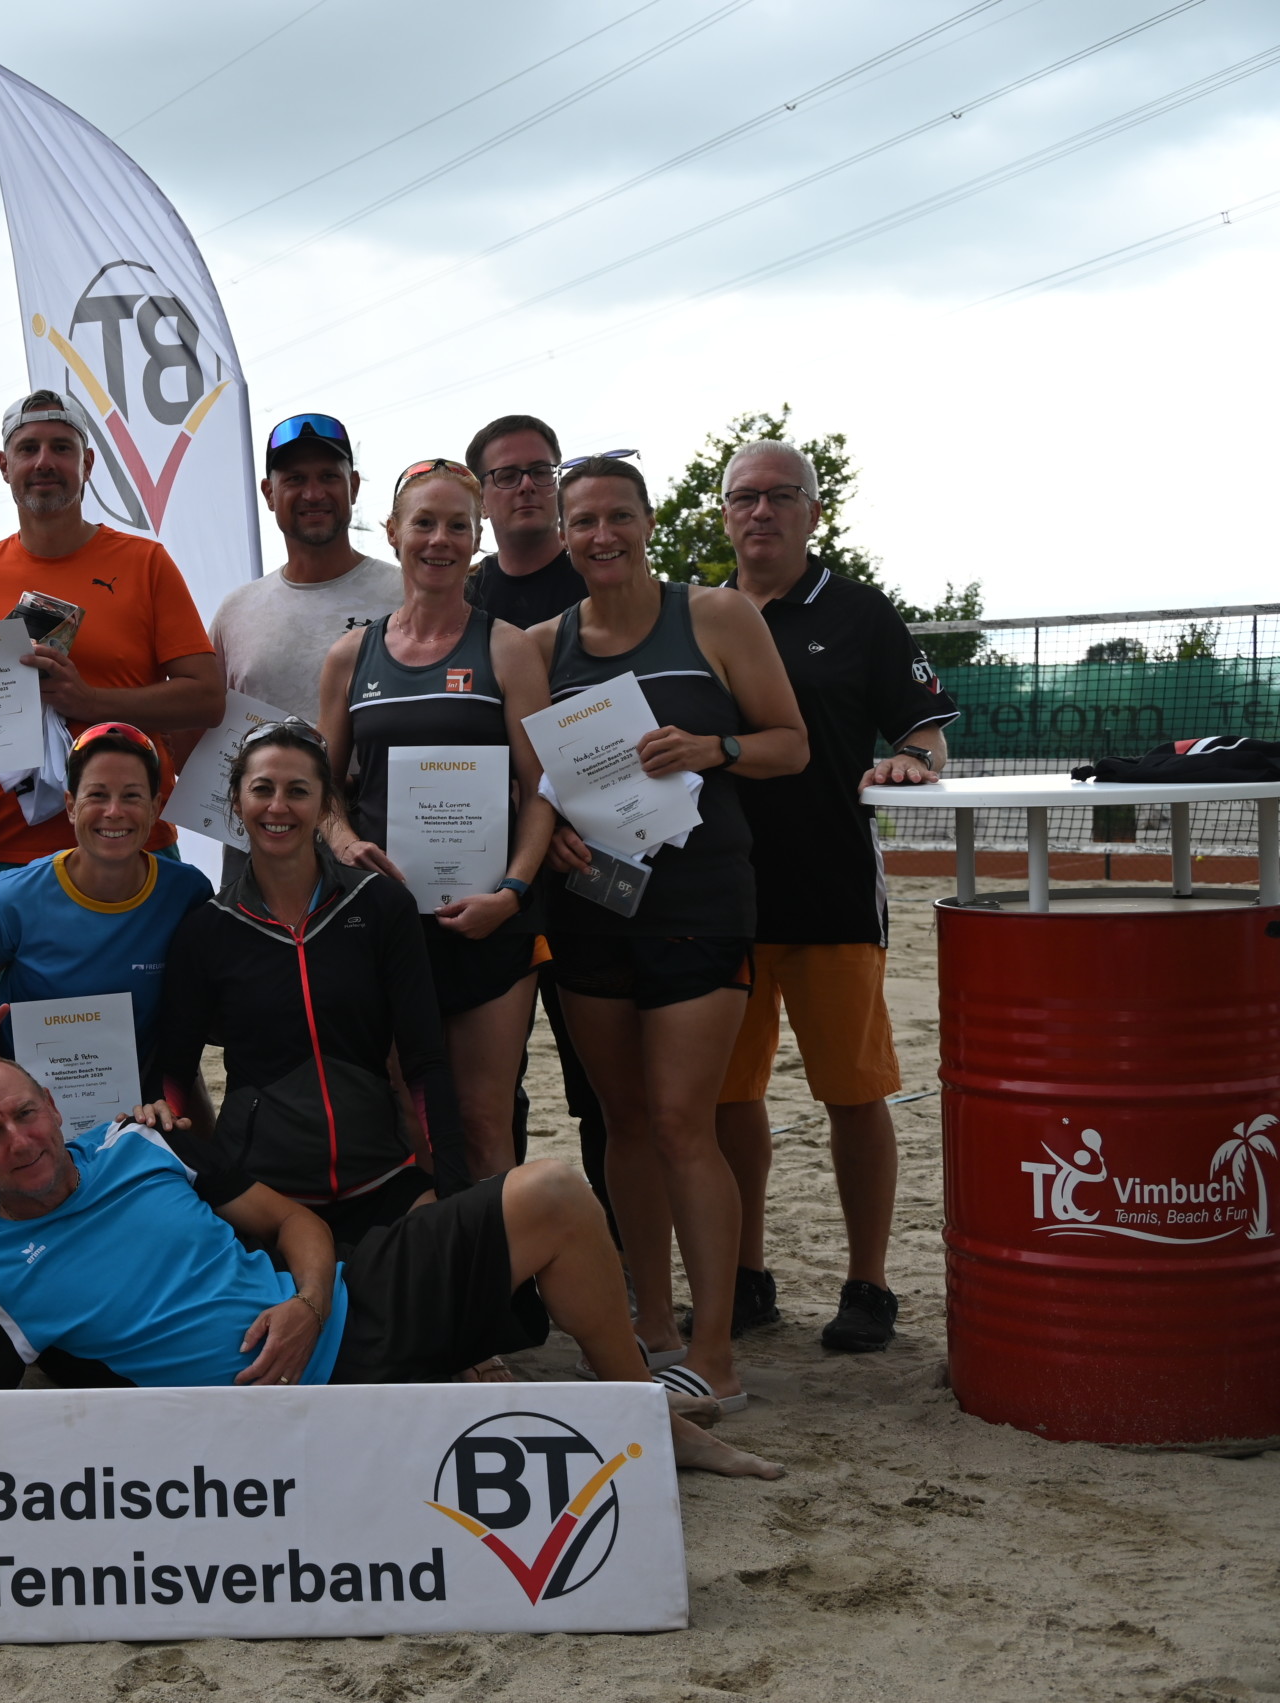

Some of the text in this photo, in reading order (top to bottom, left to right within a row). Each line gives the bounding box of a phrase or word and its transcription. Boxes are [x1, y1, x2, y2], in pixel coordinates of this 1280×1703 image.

[362, 690, 381, 699] erima
[558, 698, 612, 728] URKUNDE
[948, 691, 1170, 742] retorn
[573, 753, 594, 764] Nadja
[594, 746, 600, 754] &
[601, 738, 625, 751] Corinne
[420, 762, 476, 770] URKUNDE
[600, 782, 610, 790] den
[618, 773, 632, 782] Platz
[418, 802, 437, 811] Nadja
[44, 1012, 102, 1026] URKUNDE
[49, 1056, 72, 1064] Verena
[1112, 1175, 1237, 1204] Vimbuch
[1114, 1206, 1248, 1226] Tennis, Beach & Fun
[26, 1244, 46, 1264] erima
[453, 1437, 599, 1529] BT
